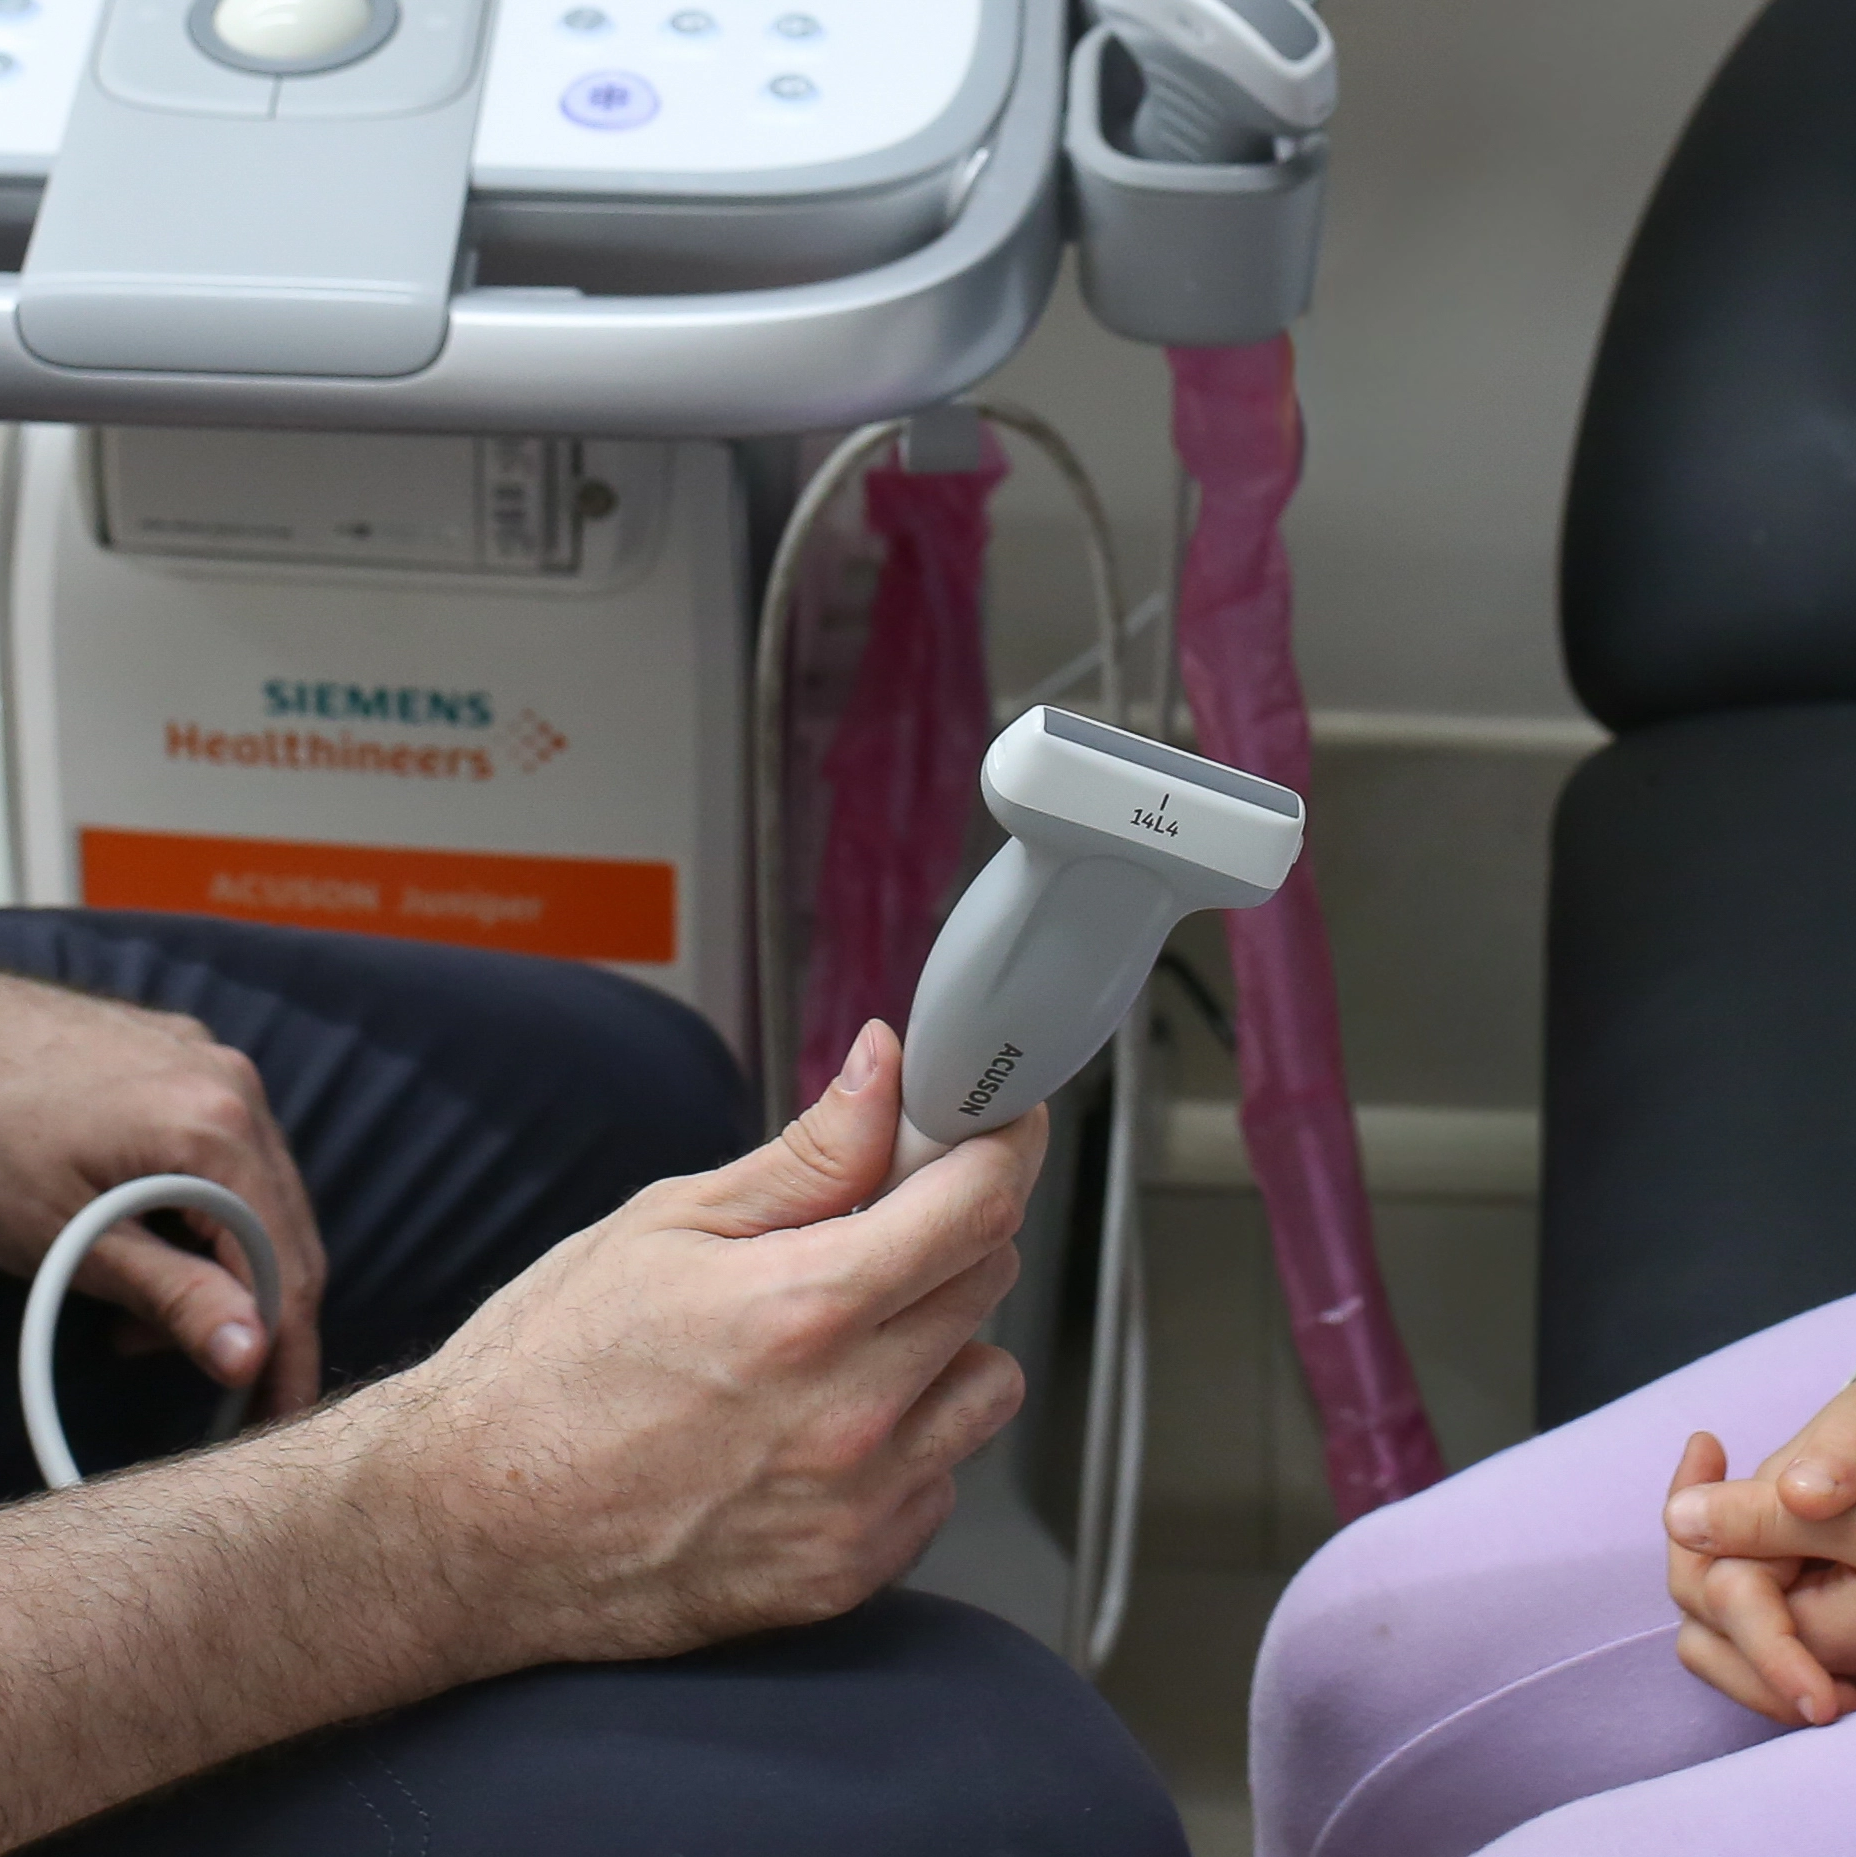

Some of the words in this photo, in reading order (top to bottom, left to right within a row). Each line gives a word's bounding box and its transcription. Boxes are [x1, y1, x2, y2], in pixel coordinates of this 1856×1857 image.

[263, 679, 494, 728] SIEMENS
[164, 720, 495, 781] Healthineers
[1130, 808, 1179, 838] 14L4
[208, 872, 381, 912] ACUSON
[958, 1042, 1024, 1118] ACUSON
